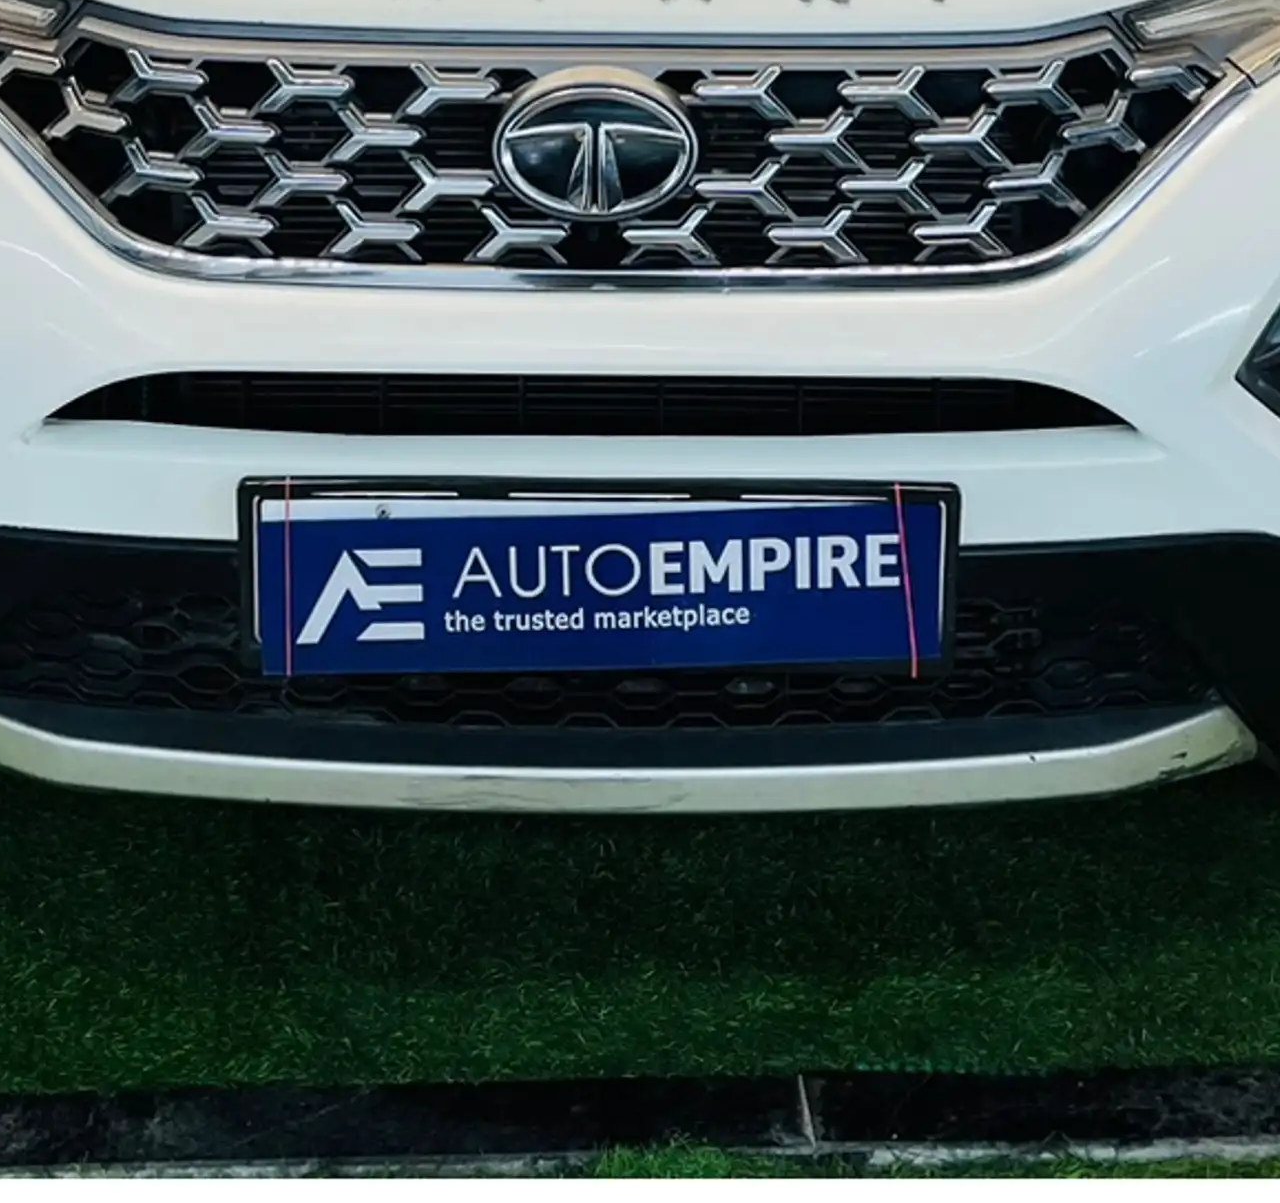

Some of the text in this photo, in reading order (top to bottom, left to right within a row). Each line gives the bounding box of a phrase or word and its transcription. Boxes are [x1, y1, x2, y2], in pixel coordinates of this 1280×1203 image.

[444, 603, 751, 633] the trusted marketplace
